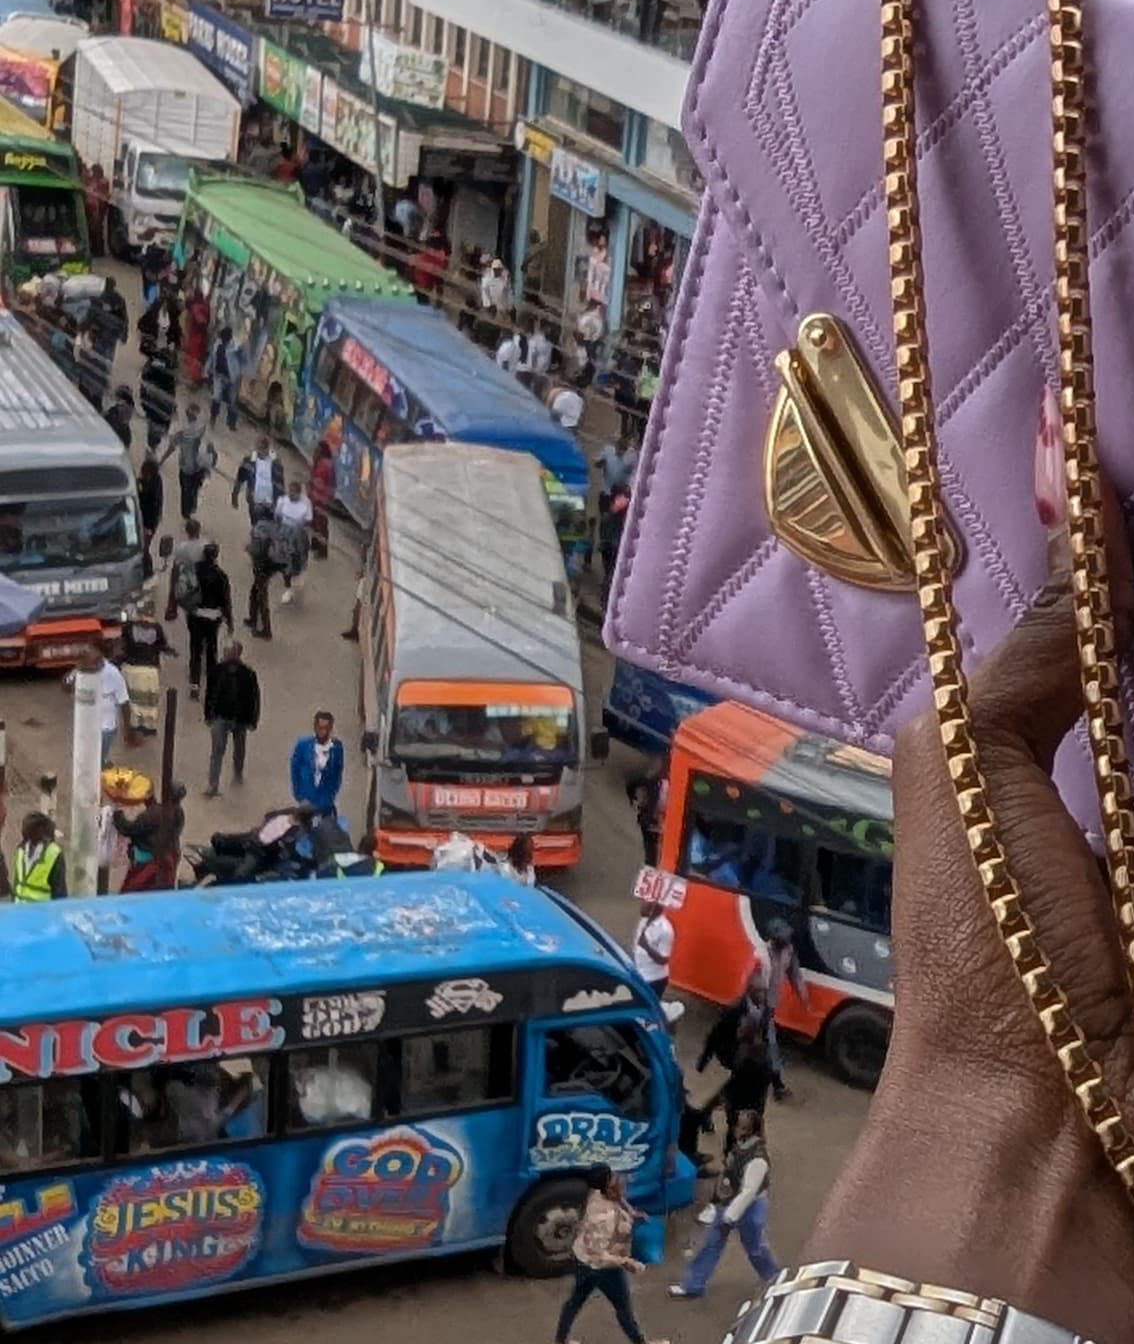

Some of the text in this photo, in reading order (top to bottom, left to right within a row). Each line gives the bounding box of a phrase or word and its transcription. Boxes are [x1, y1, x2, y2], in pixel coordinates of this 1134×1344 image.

[64, 577, 109, 594] METRO
[333, 1144, 453, 1186] GOD
[97, 1188, 240, 1241] JESUS
[124, 1235, 219, 1273] KING
[0, 1258, 54, 1297] SACCO
